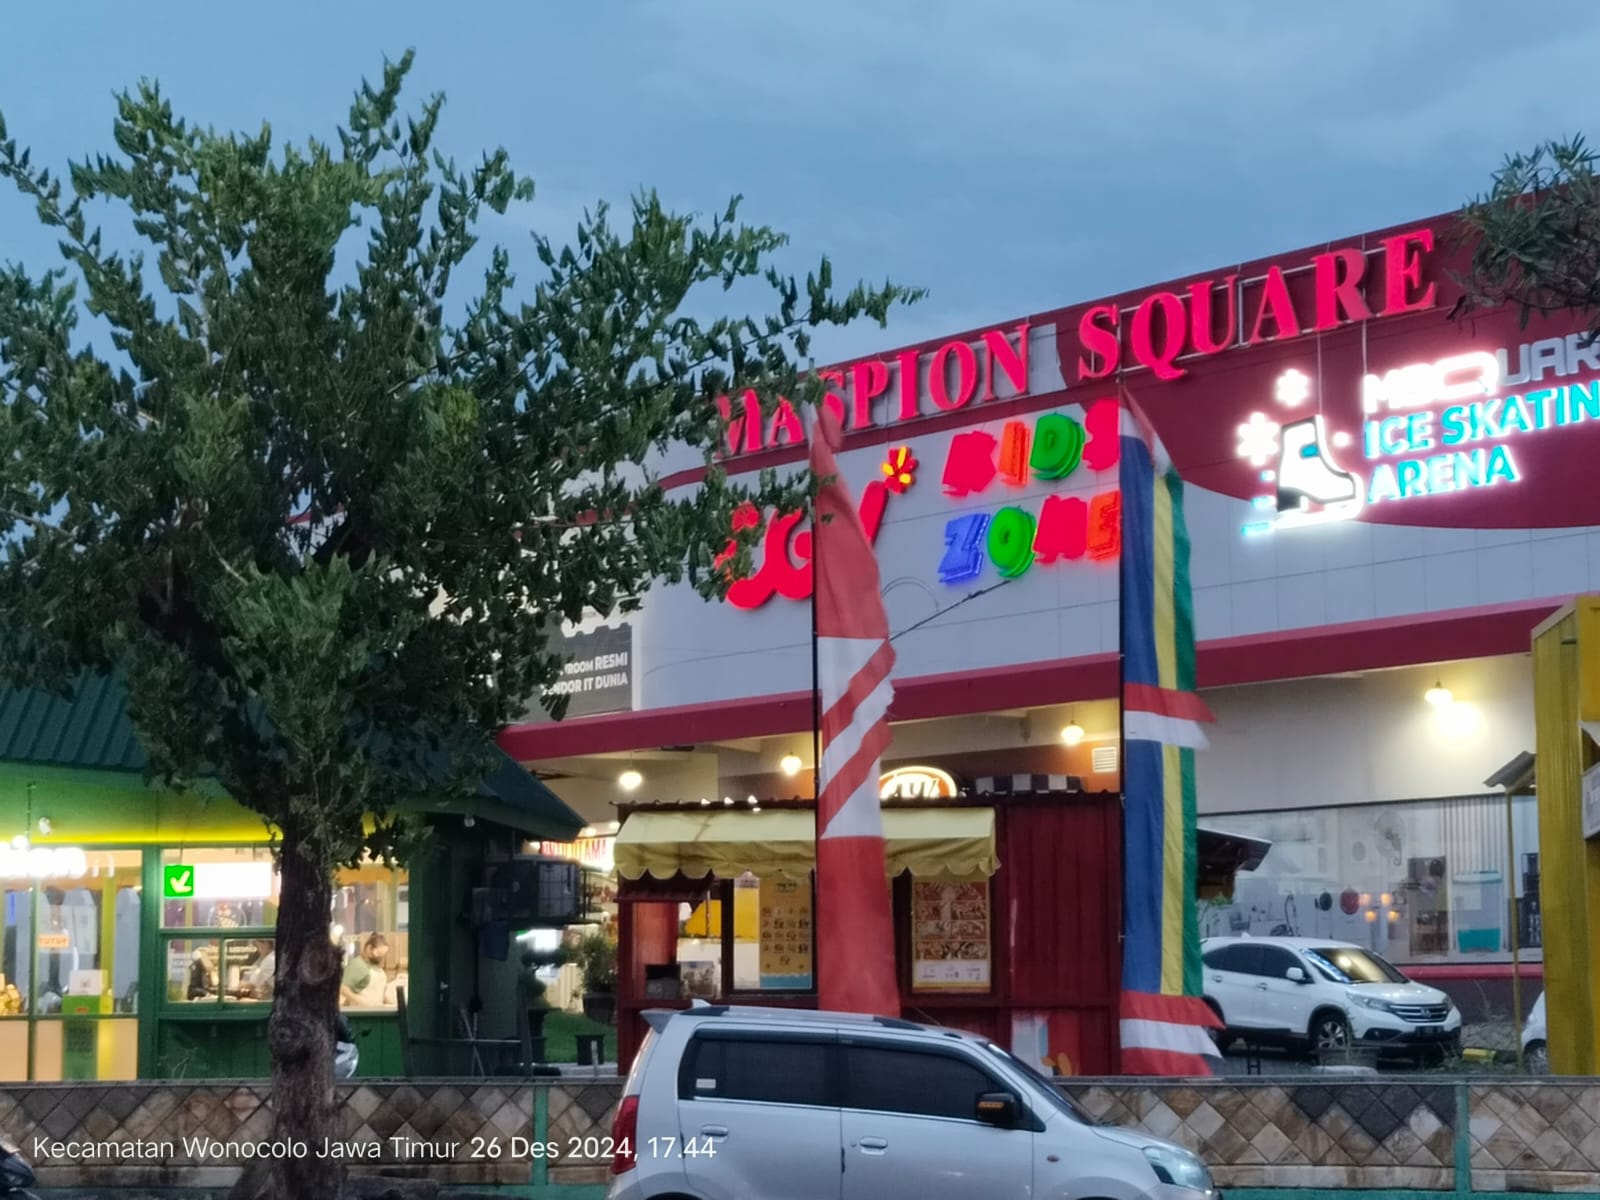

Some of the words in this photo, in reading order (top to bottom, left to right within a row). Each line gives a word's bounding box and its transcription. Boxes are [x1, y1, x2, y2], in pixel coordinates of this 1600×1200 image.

[1077, 229, 1436, 381] SQUARE
[1364, 411, 1435, 459] ICE
[1441, 379, 1600, 445] SKATIN
[1367, 444, 1520, 503] ARENA
[583, 677, 595, 691] IT
[595, 672, 628, 690] DUNIA
[594, 651, 628, 670] RESMI
